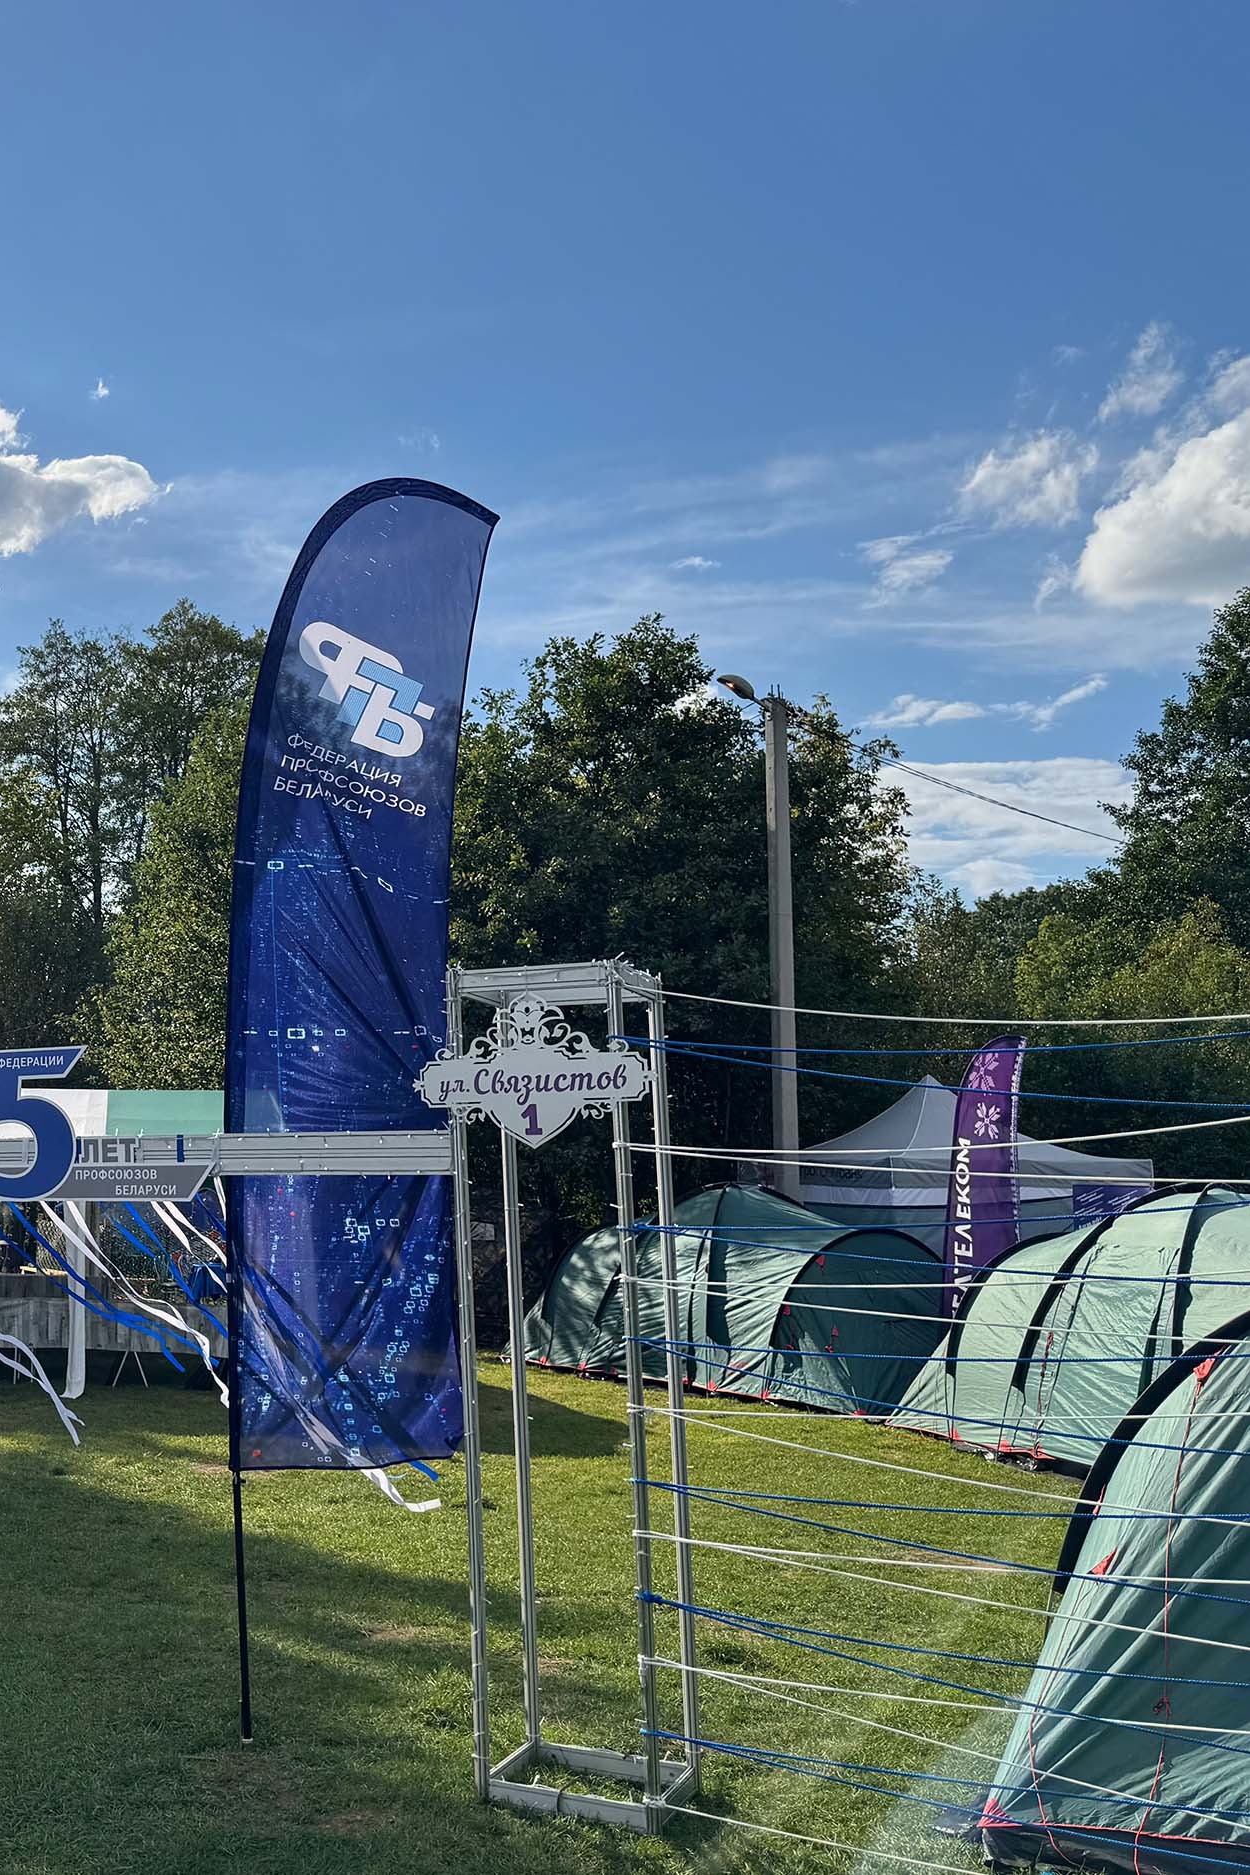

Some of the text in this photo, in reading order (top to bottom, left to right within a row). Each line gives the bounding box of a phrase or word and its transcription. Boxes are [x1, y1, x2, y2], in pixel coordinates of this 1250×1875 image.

[287, 733, 402, 788] ФЕДЕРАЦИЯ
[281, 754, 427, 817] ПРОФСОЮЗОВ
[439, 1063, 627, 1105] ул. Связистов
[521, 1103, 543, 1136] 1
[81, 1138, 136, 1163] ЛЕТ
[75, 1169, 158, 1180] ПРОФСОЮЗОВ
[115, 1185, 177, 1196] БЕЛАРУСИ
[952, 1138, 973, 1319] ЛТЕЛЕКОМ
